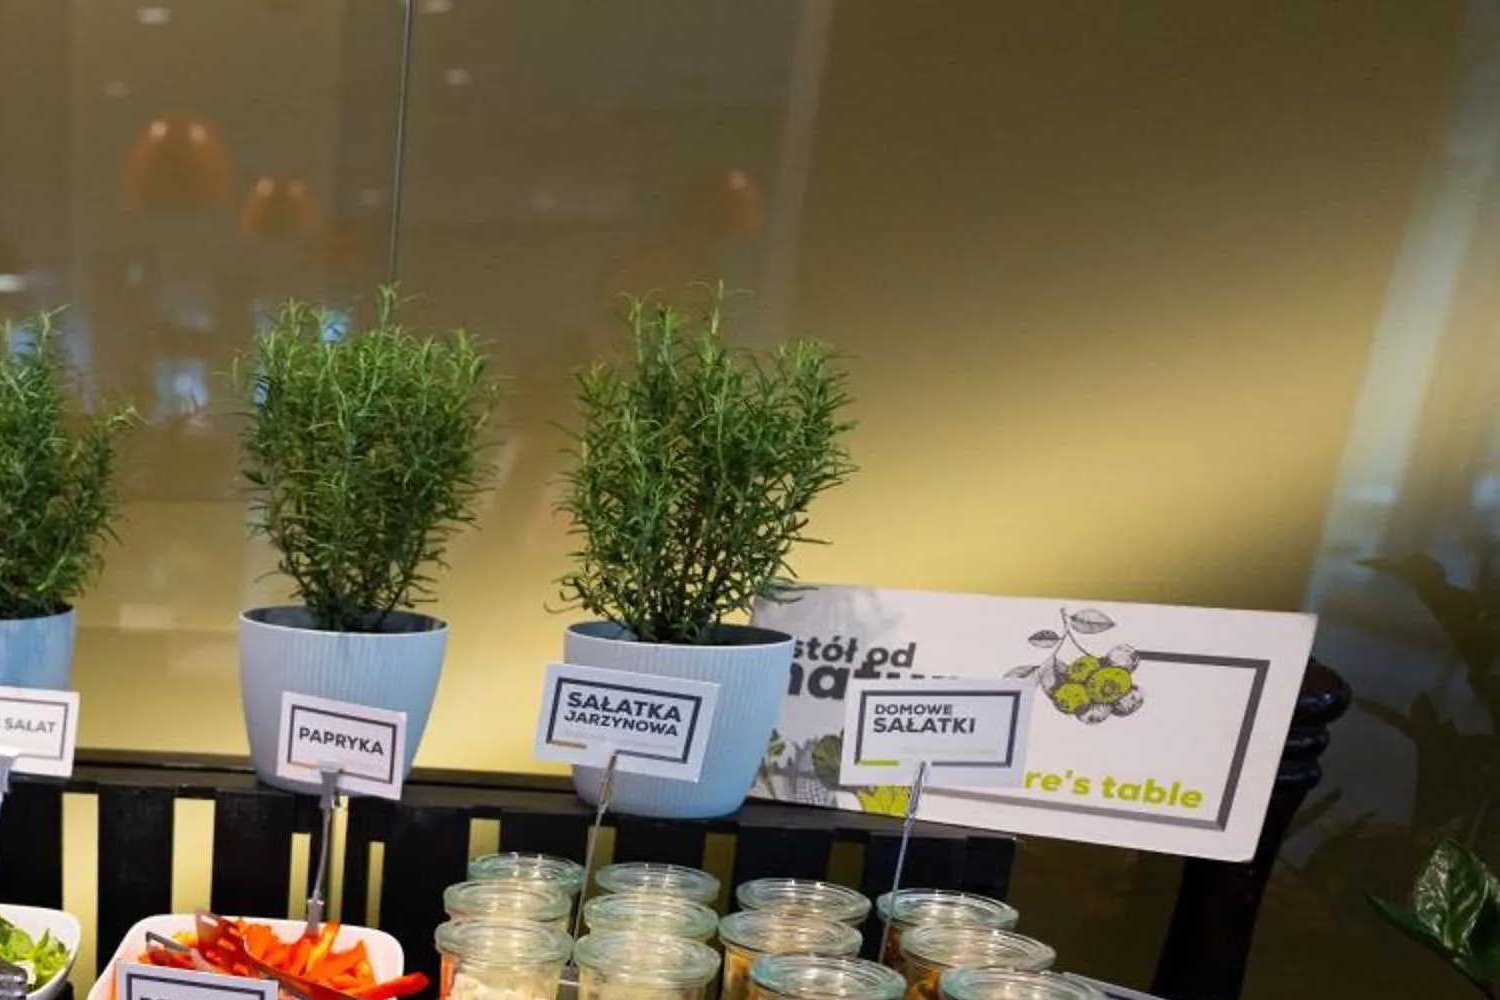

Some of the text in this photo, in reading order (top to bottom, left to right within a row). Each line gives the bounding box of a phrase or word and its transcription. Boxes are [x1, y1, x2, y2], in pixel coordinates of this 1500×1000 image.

[867, 642, 916, 668] od
[567, 692, 681, 722] SAŁATKA
[875, 704, 953, 715] DOMOWE
[564, 710, 678, 737] JARZYNOWA
[874, 717, 976, 734] SAŁATKI
[299, 727, 384, 755] PAPRYKA
[1024, 770, 1203, 808] re's table
